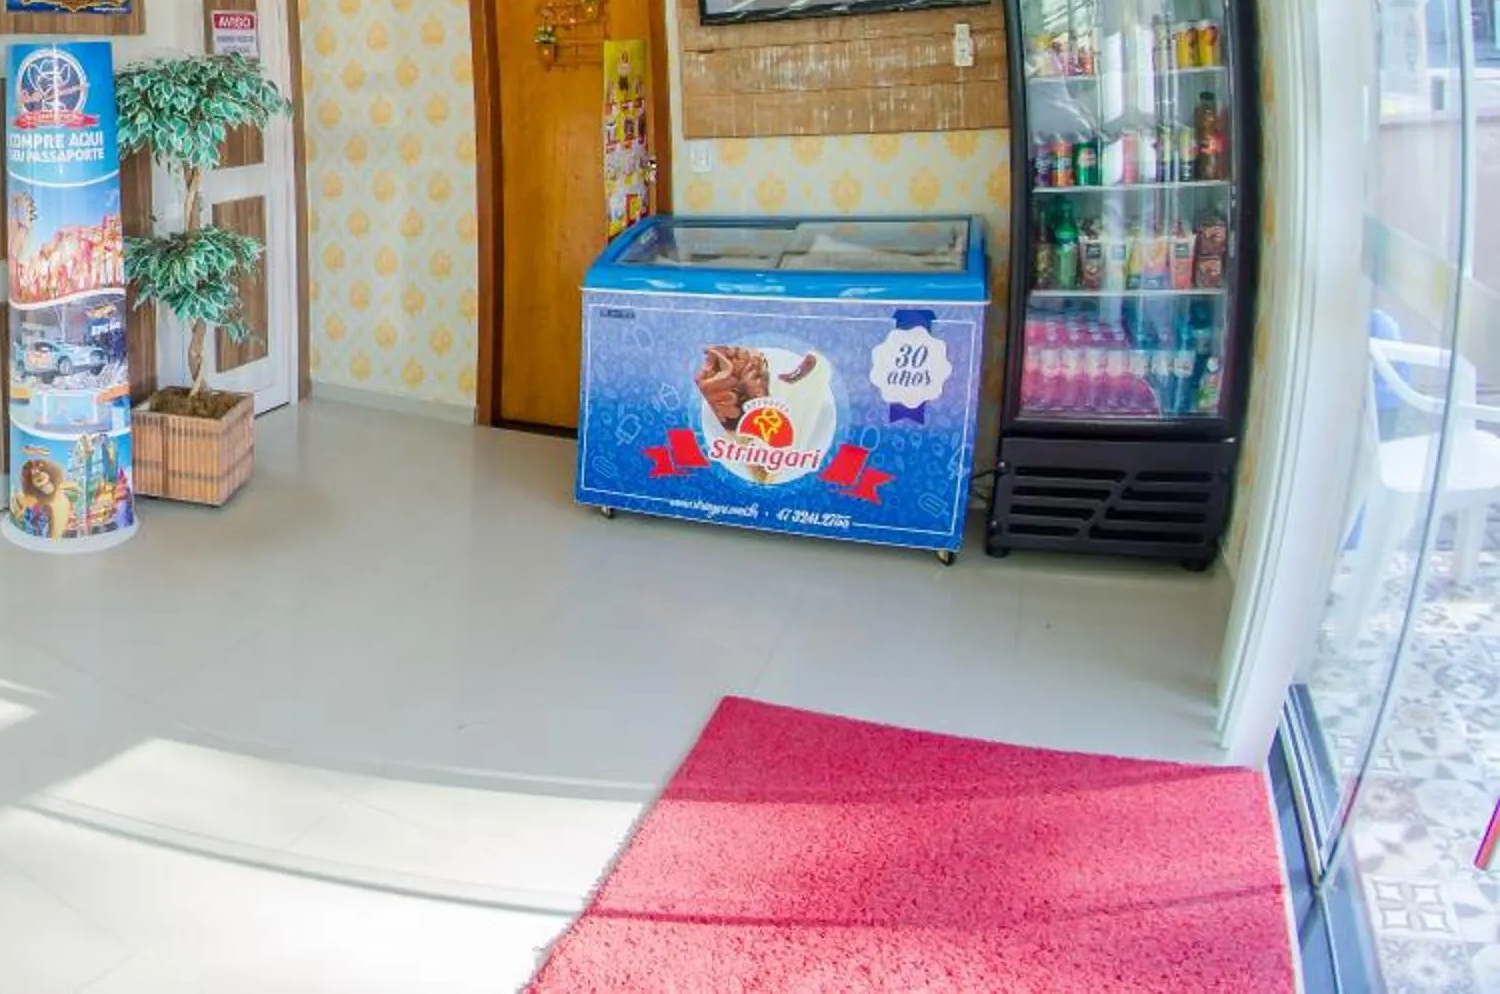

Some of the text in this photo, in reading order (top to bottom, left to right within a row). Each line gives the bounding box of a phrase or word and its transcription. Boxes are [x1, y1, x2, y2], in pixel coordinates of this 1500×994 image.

[68, 130, 104, 147] AQUI
[896, 344, 929, 368] 30
[887, 369, 931, 387] anos
[710, 439, 821, 472] Stringari
